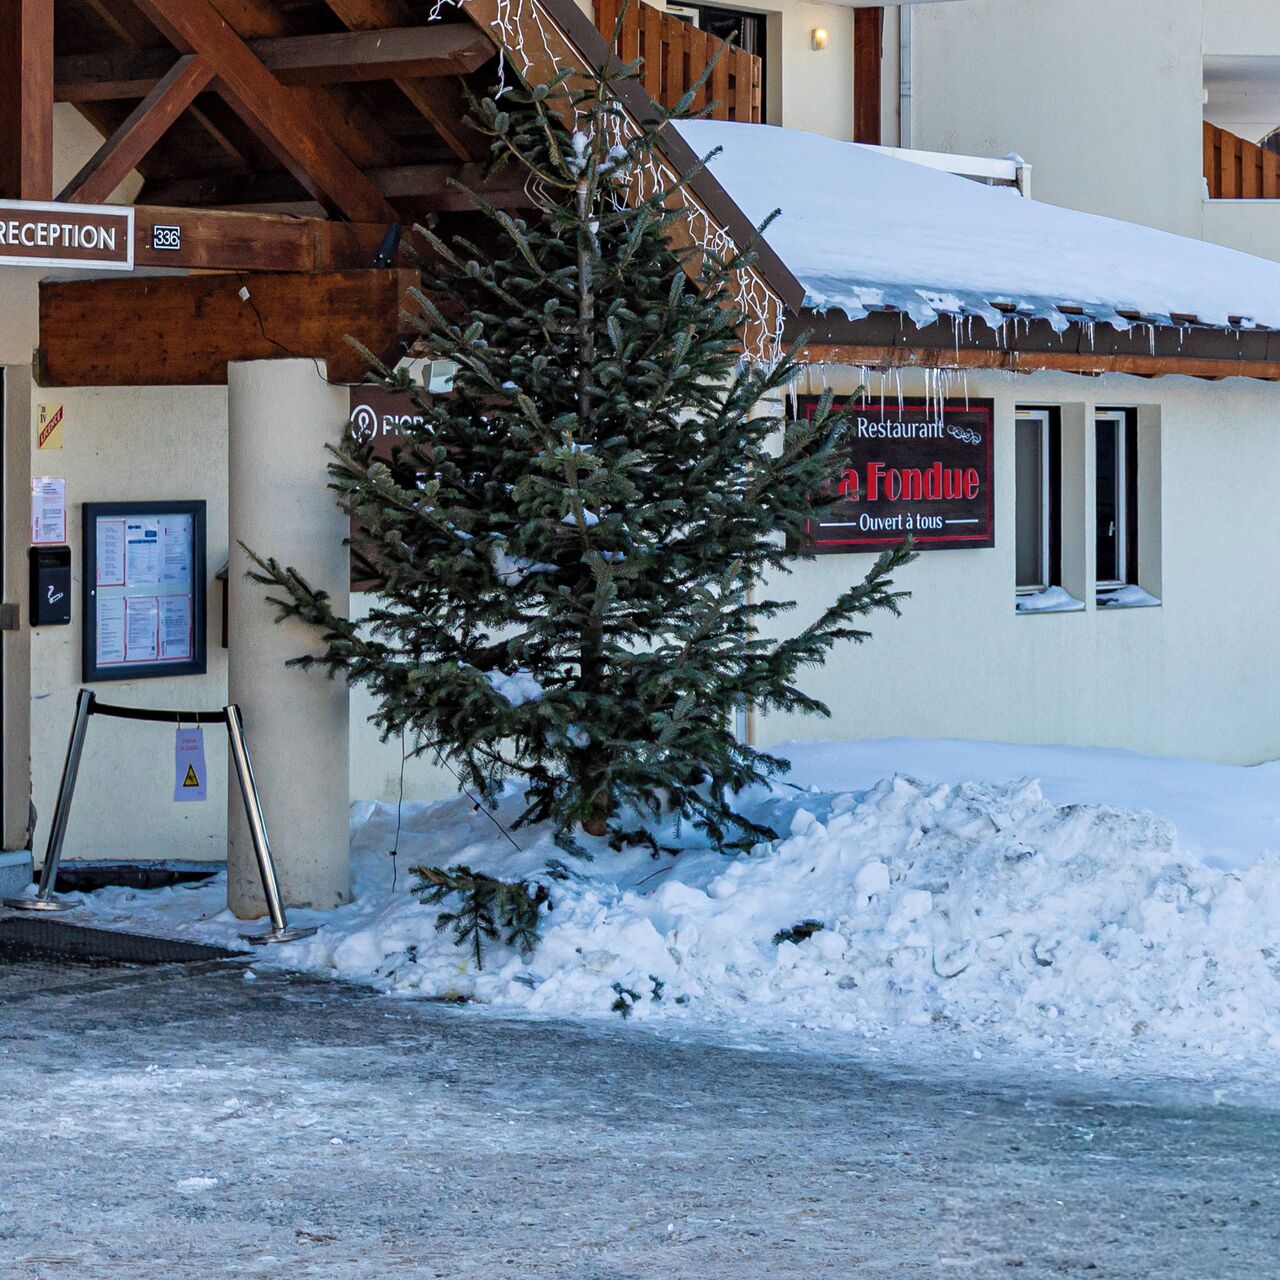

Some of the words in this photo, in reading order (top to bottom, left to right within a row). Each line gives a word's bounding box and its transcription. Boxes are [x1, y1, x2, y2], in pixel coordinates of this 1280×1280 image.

[156, 230, 180, 245] 336
[856, 417, 945, 439] Restaurant
[866, 461, 981, 502] Fondue
[859, 513, 903, 531] Ouvert
[905, 512, 914, 530] à
[916, 514, 943, 530] tous
